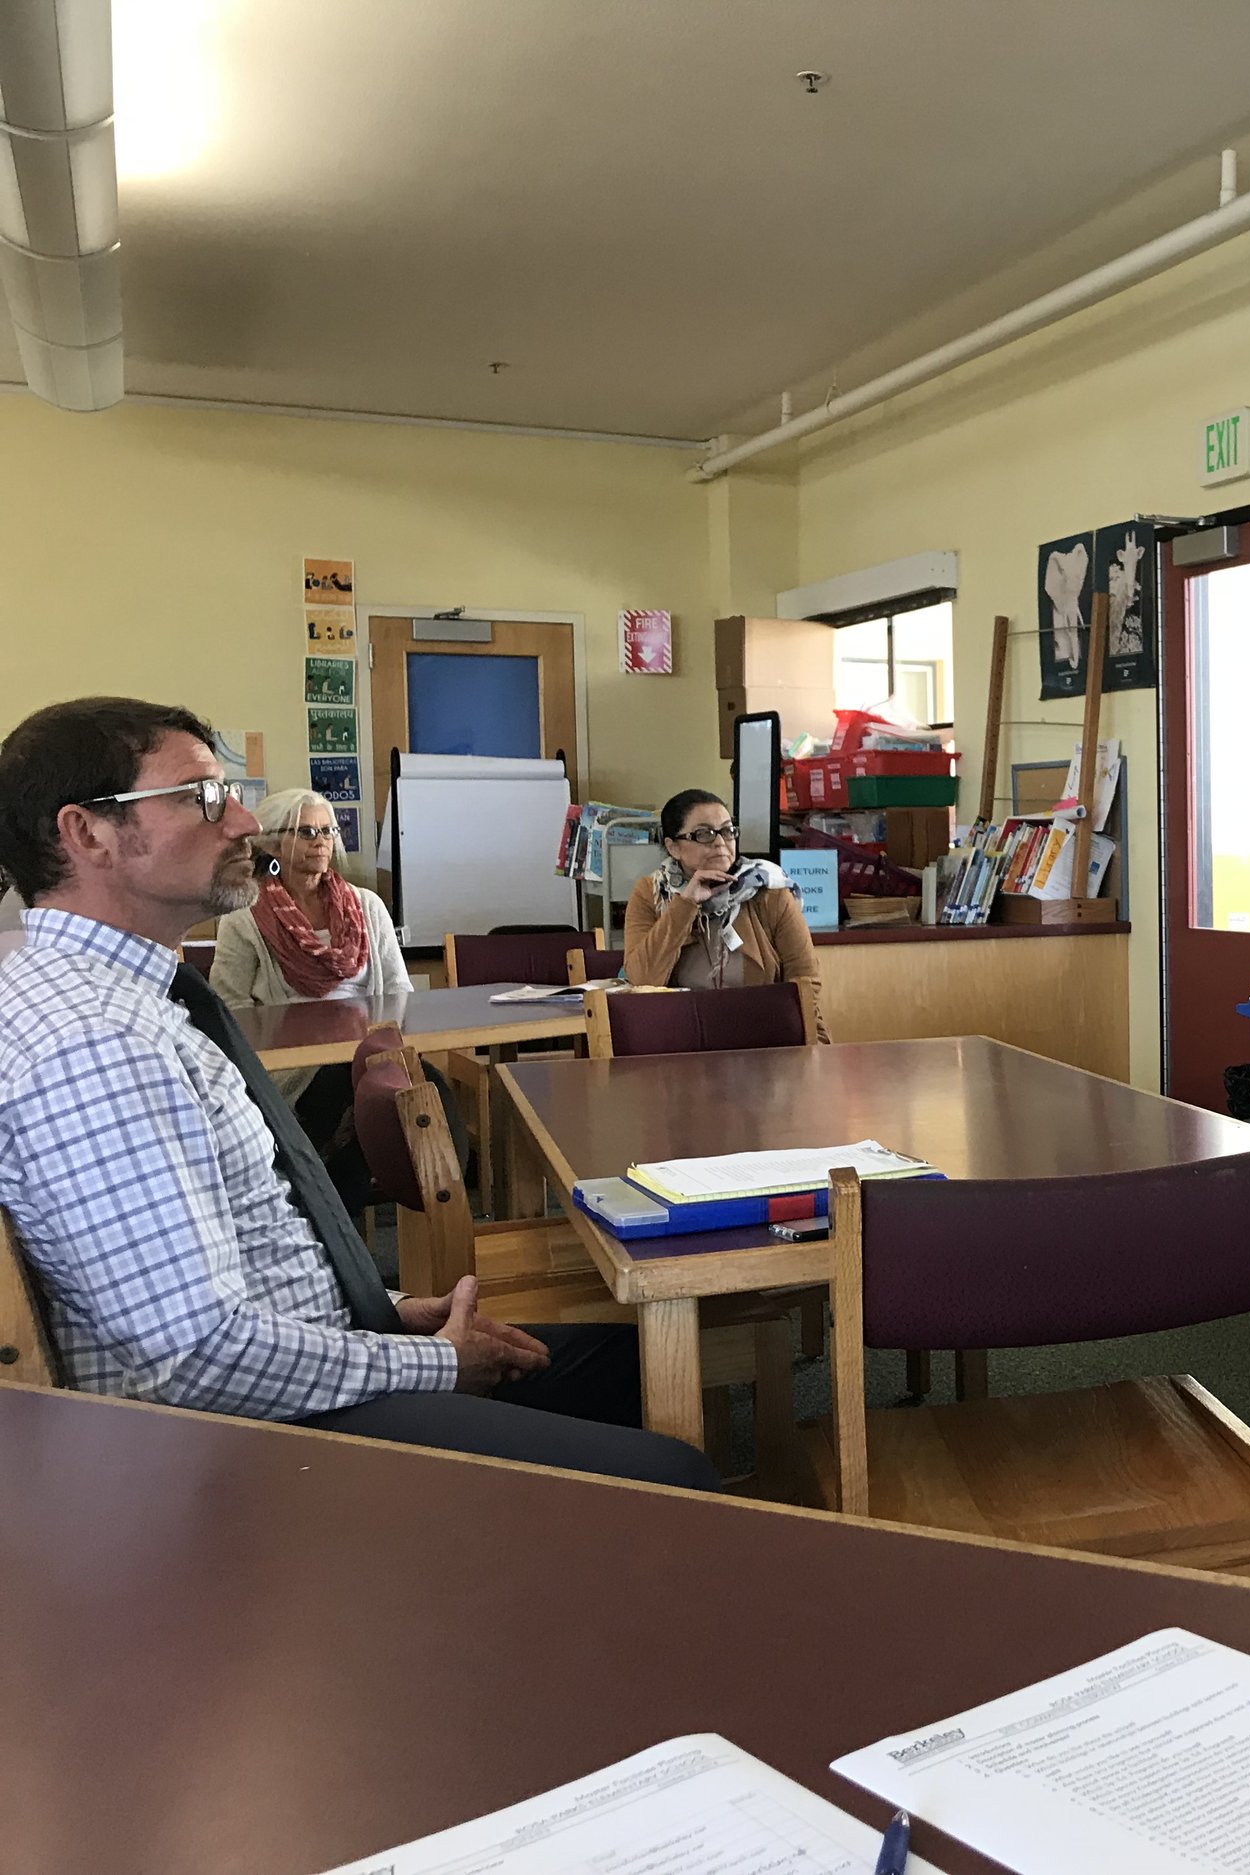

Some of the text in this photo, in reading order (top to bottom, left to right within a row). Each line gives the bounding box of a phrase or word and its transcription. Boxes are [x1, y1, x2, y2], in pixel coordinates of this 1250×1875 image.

[1206, 416, 1240, 473] EXIT
[636, 618, 657, 629] FIRE
[310, 660, 349, 670] LIBRARIES
[307, 693, 350, 702] EVERYONE
[320, 790, 355, 800] ODOS
[887, 1729, 965, 1760] Berkeley
